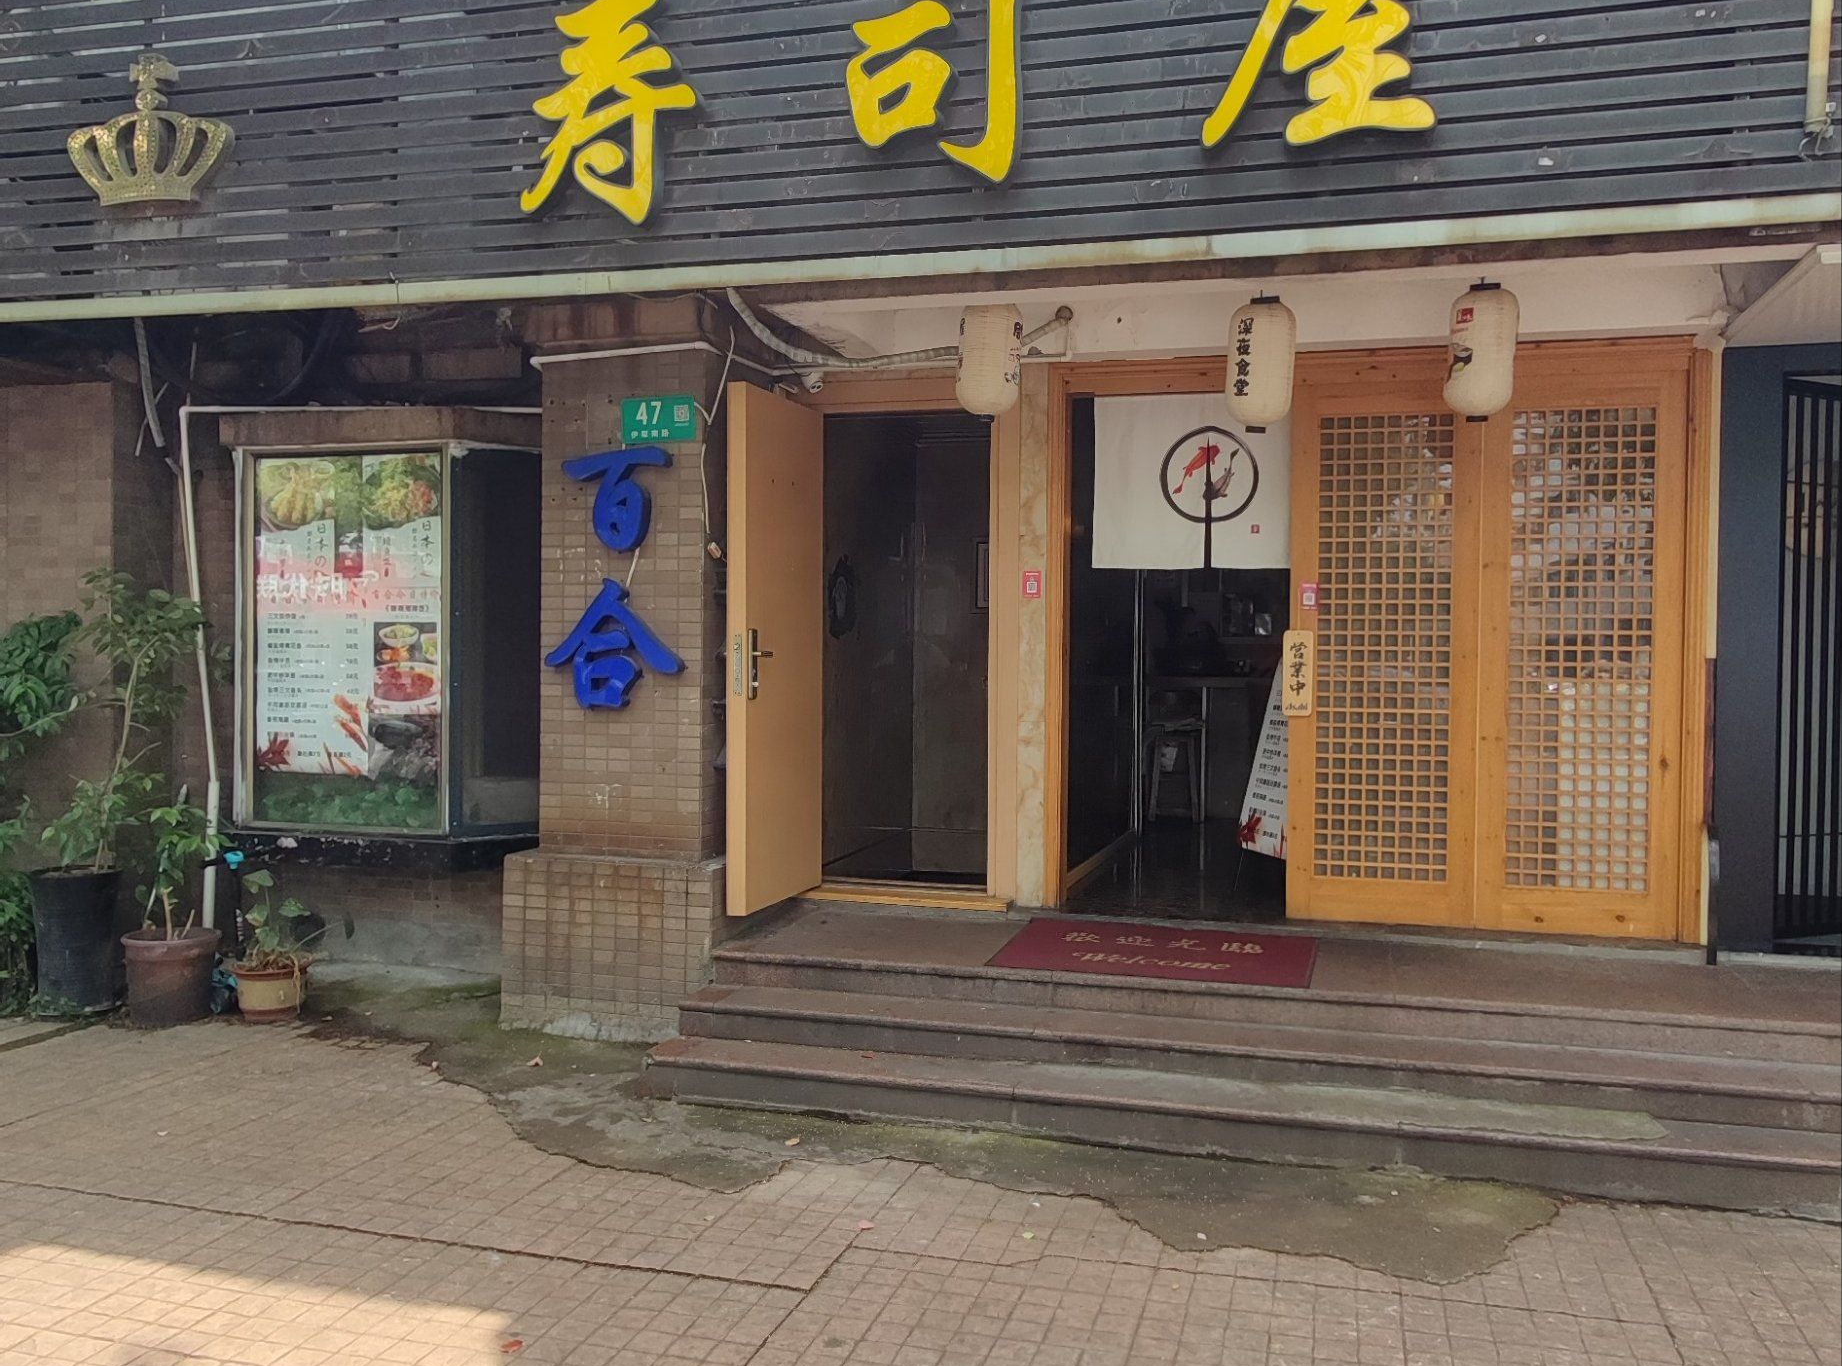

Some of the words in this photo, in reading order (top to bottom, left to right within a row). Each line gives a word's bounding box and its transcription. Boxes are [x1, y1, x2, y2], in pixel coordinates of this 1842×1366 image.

[1233, 317, 1254, 396] 深夜食堂
[635, 401, 662, 425] 47
[544, 446, 686, 710] 百合
[1072, 951, 1232, 971] Welcome
